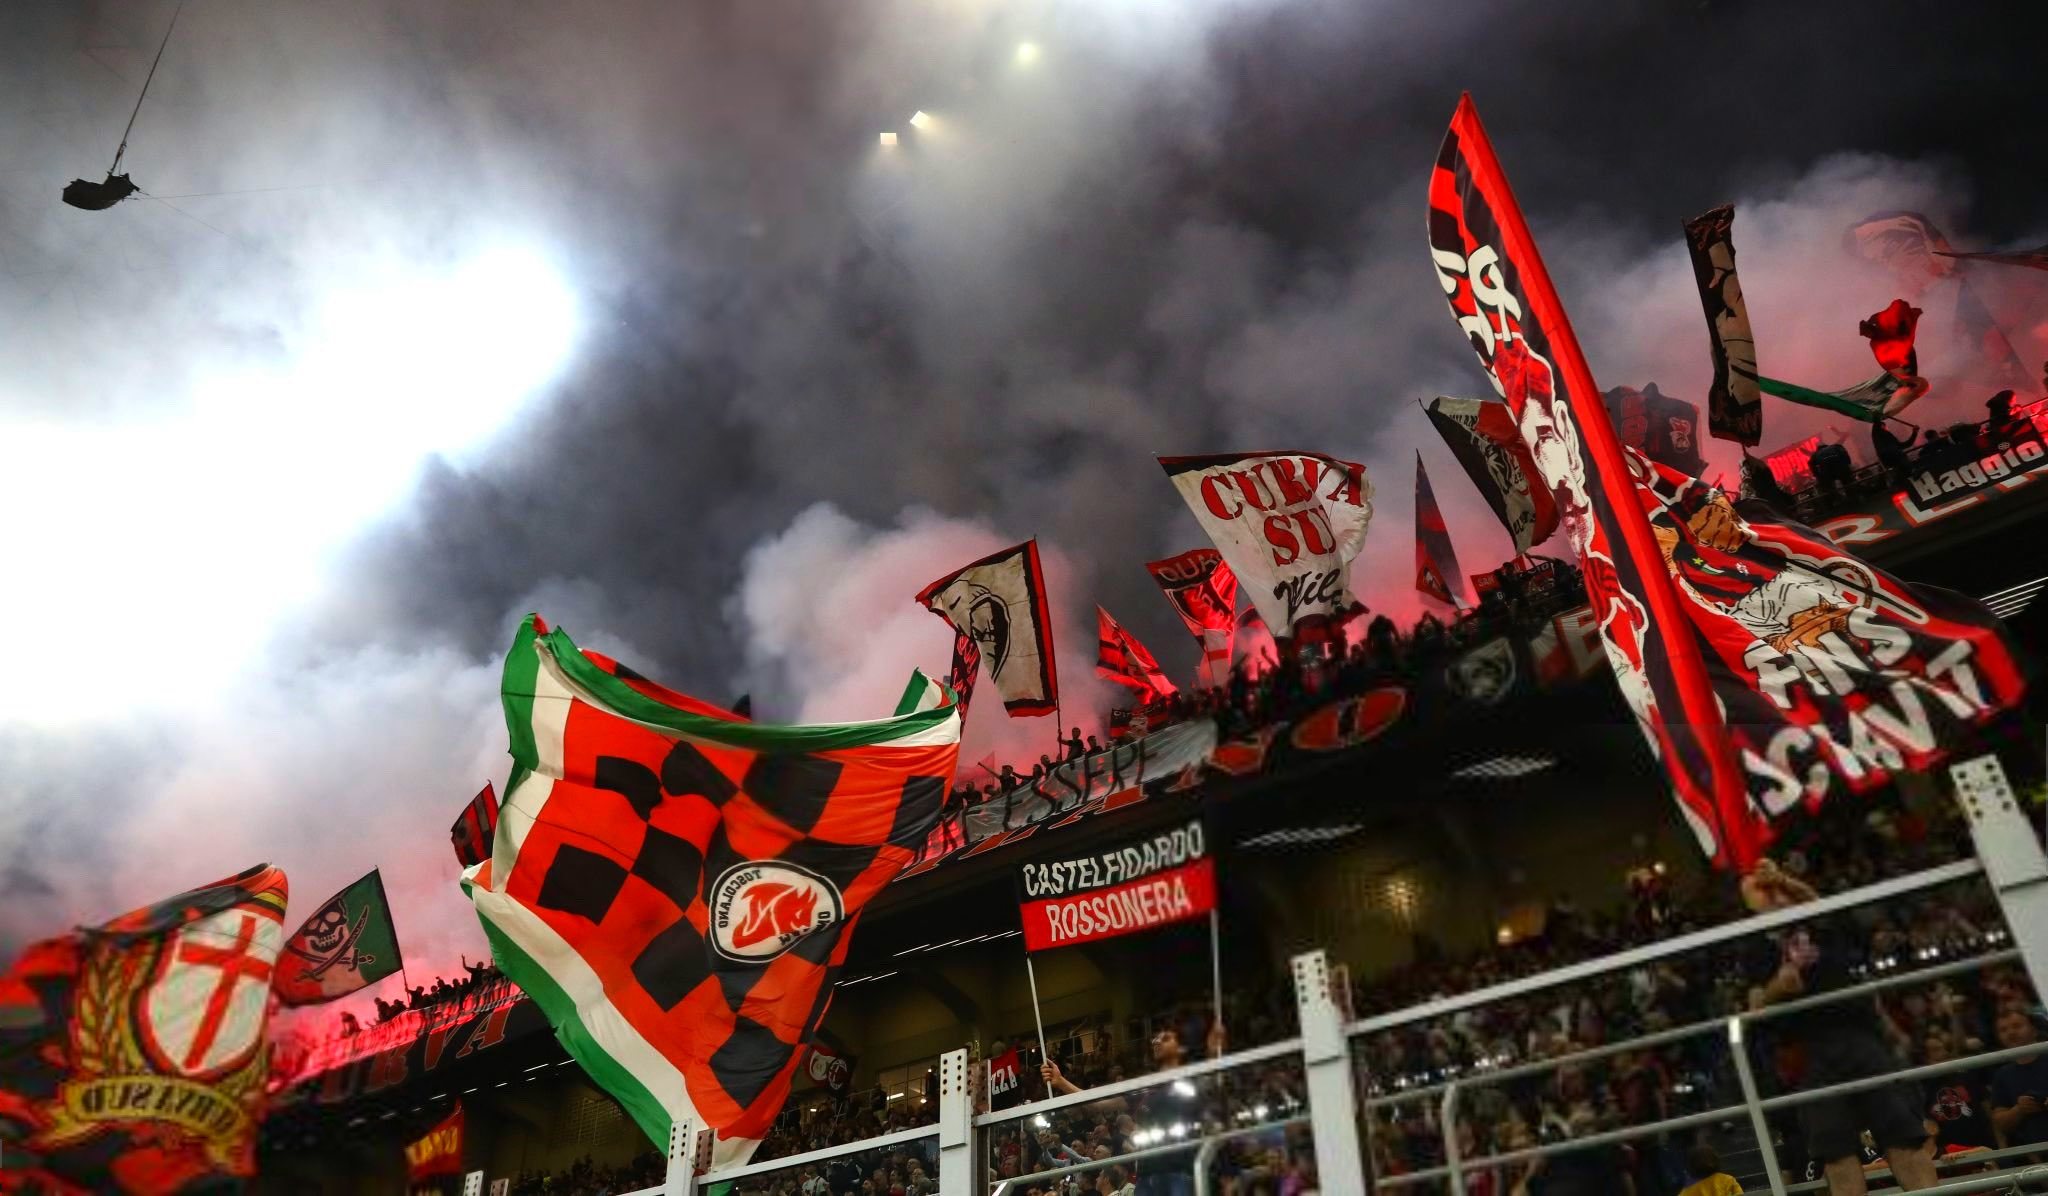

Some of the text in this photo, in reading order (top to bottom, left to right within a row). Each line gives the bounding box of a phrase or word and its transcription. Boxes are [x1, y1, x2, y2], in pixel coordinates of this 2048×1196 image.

[1201, 456, 1366, 521] CURVA
[1908, 440, 2045, 502] Baggio
[1023, 821, 1206, 897] CASTELFIDARDO
[1047, 878, 1191, 942] ROSSONERA
